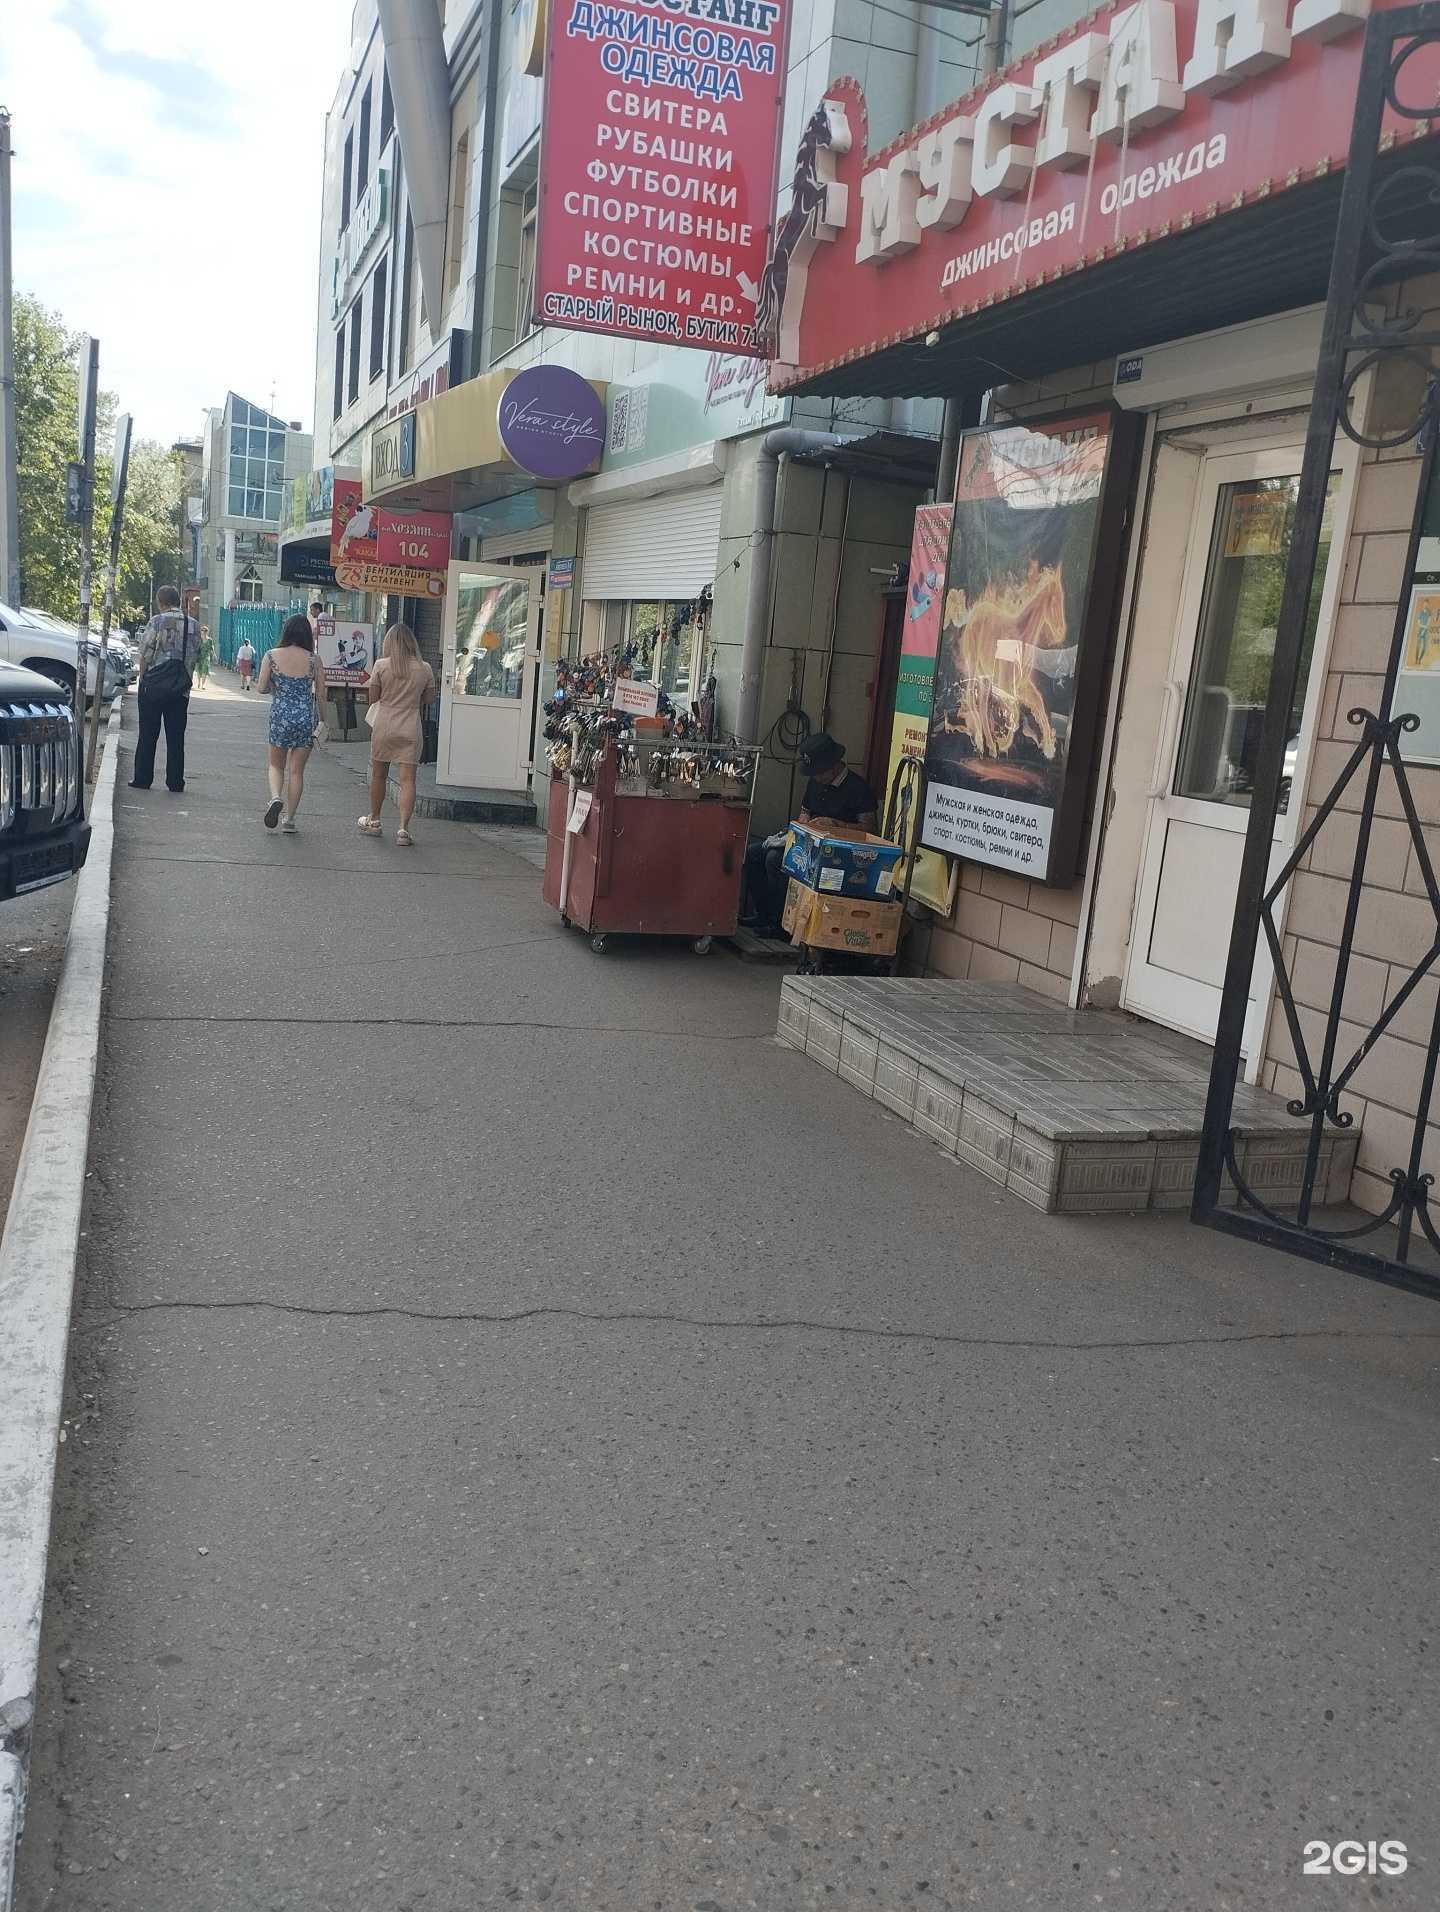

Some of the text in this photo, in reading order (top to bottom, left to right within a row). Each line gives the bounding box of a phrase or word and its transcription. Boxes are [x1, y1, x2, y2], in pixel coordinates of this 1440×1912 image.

[568, 1, 776, 73] ДЖИНСОВАЯ
[601, 41, 743, 101] ОДЕЖДА
[606, 90, 728, 135] СВИТЕРА
[856, 0, 1366, 264] МУСТАН
[597, 123, 733, 172] РУБАШКИ
[586, 159, 737, 208] ФУТБОЛКИ
[564, 191, 752, 246] СПОРТИВНЫЕ
[941, 133, 1226, 287] джинсовая одежда
[584, 230, 732, 278] КОСТЮМЫ
[567, 263, 743, 316] РЕМНИ и др.
[544, 293, 614, 324] СТАРЫЙ
[617, 304, 682, 339] РЫНОК,
[686, 315, 738, 344] БУТИК
[505, 397, 604, 444] Vera style
[375, 435, 400, 480] ВХОД
[366, 565, 431, 580] ВЕНТИЛЯЦИЯ
[399, 541, 429, 559] 104
[935, 793, 966, 811] Мужская
[973, 806, 1004, 820] женская
[989, 842, 1013, 857] ремни
